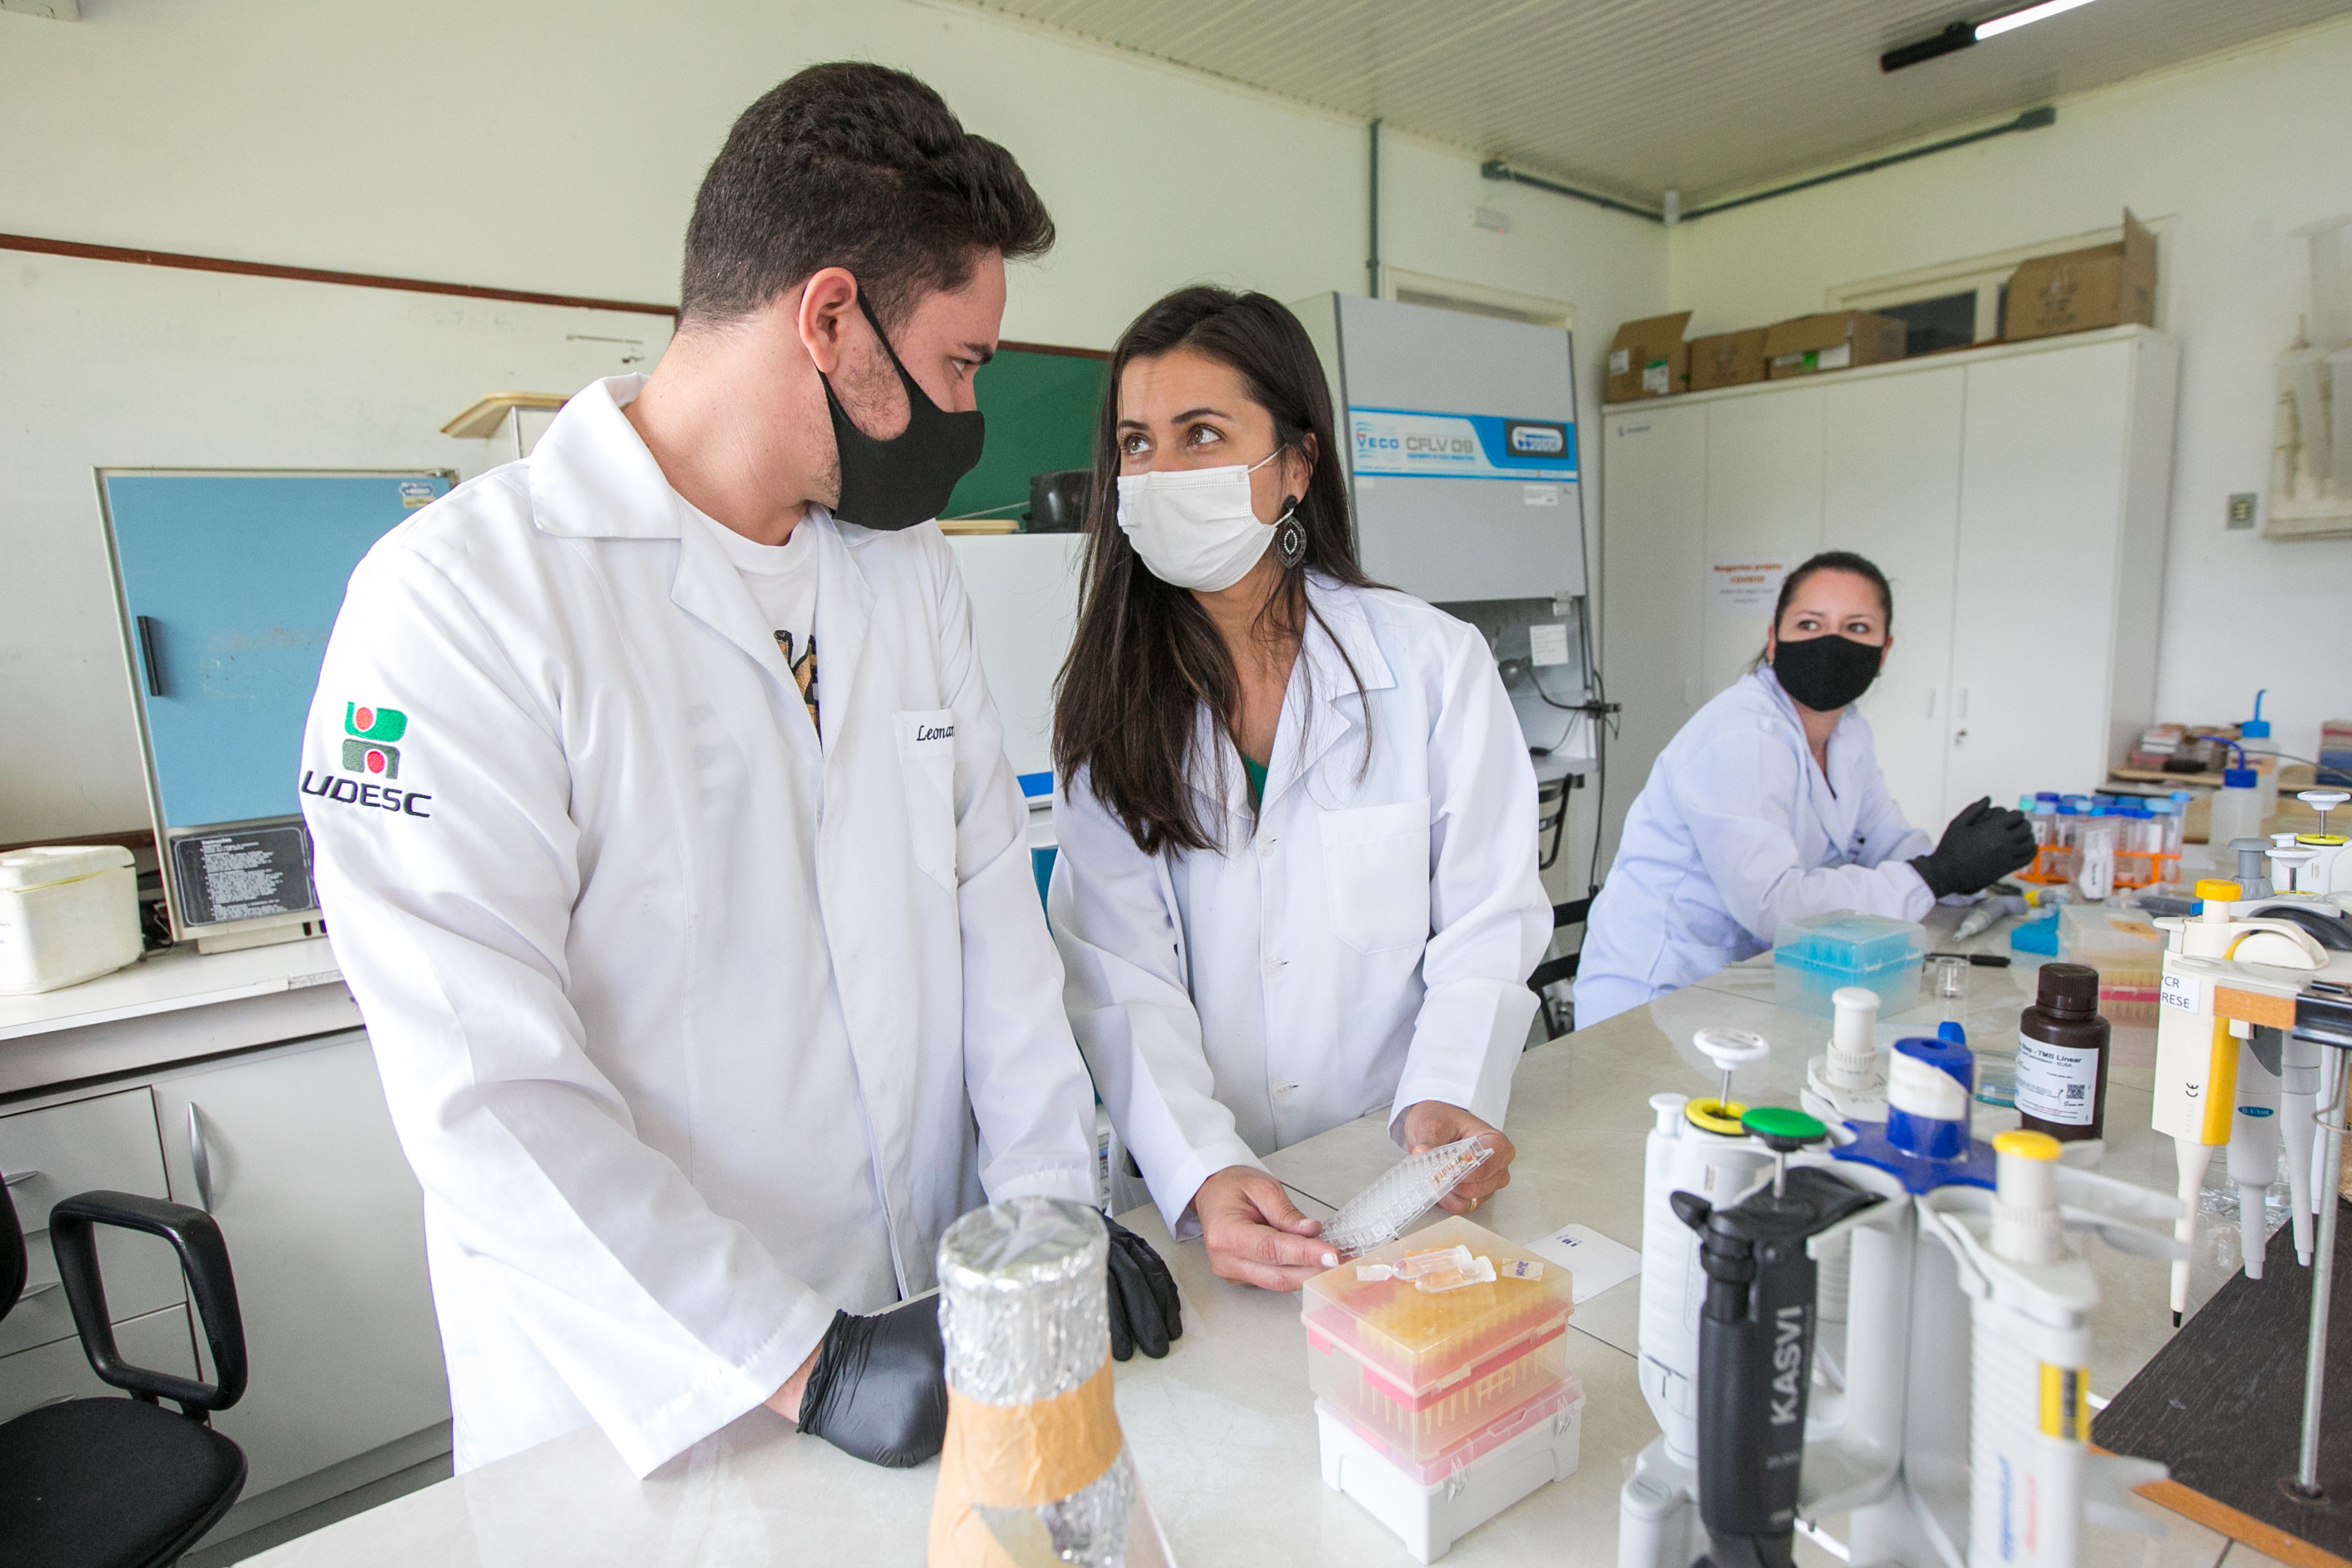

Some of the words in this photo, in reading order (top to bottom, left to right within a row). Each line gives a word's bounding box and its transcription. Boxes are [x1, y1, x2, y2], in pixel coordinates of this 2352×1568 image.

[1357, 436, 1399, 448] VECO
[1406, 437, 1447, 452] CFLV
[301, 771, 432, 818] UDESC
[2162, 992, 2190, 1009] RESE
[2038, 1050, 2054, 1060] TMB
[2057, 1055, 2082, 1064] Linear
[1770, 1305, 1803, 1425] KASVI
